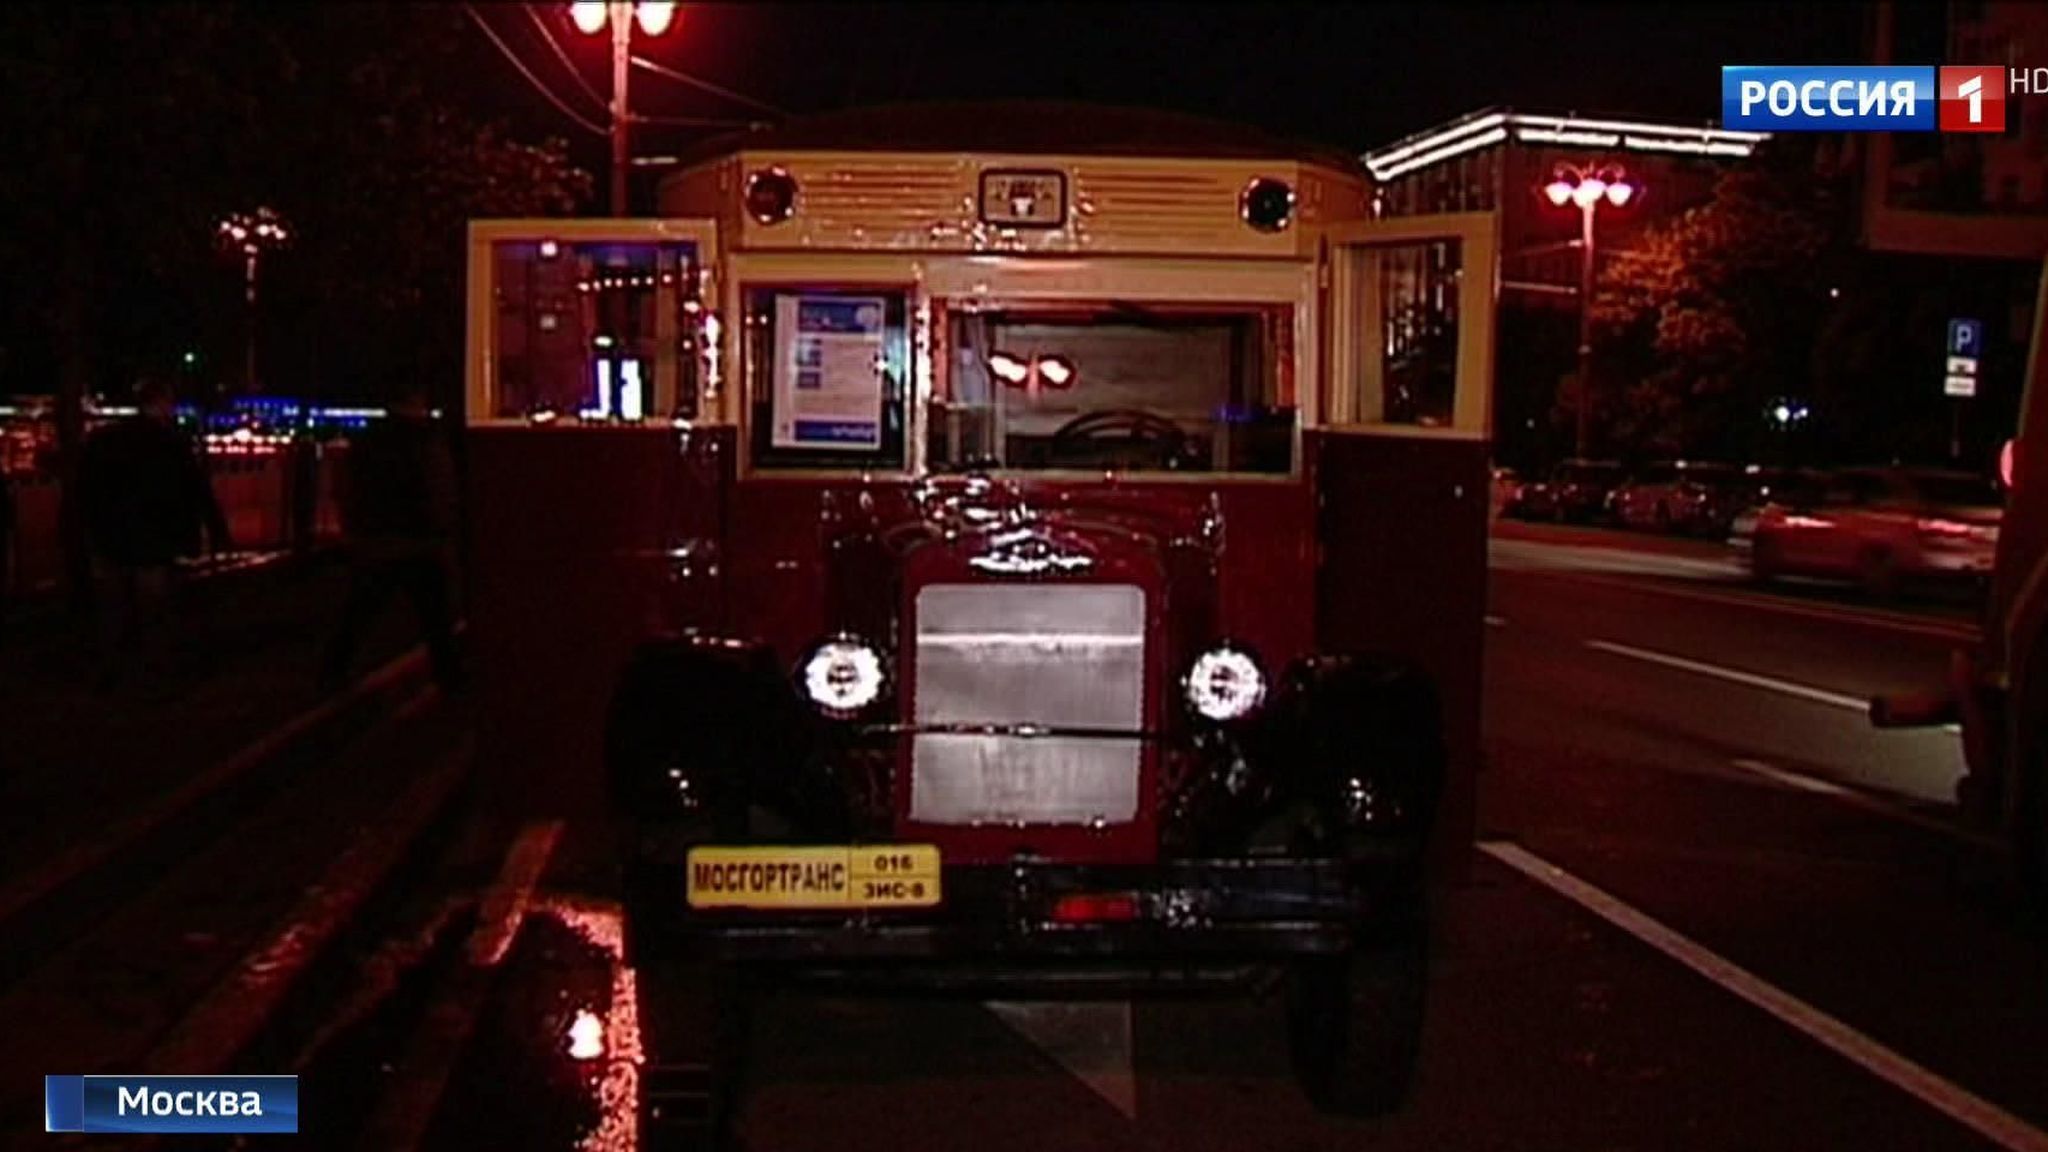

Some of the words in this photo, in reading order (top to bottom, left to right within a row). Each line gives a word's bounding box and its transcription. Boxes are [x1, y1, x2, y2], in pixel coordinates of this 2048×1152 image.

[1956, 325, 1972, 352] P
[693, 862, 846, 893] МОСГОРТРАНС
[864, 881, 925, 900] ЗИС-8
